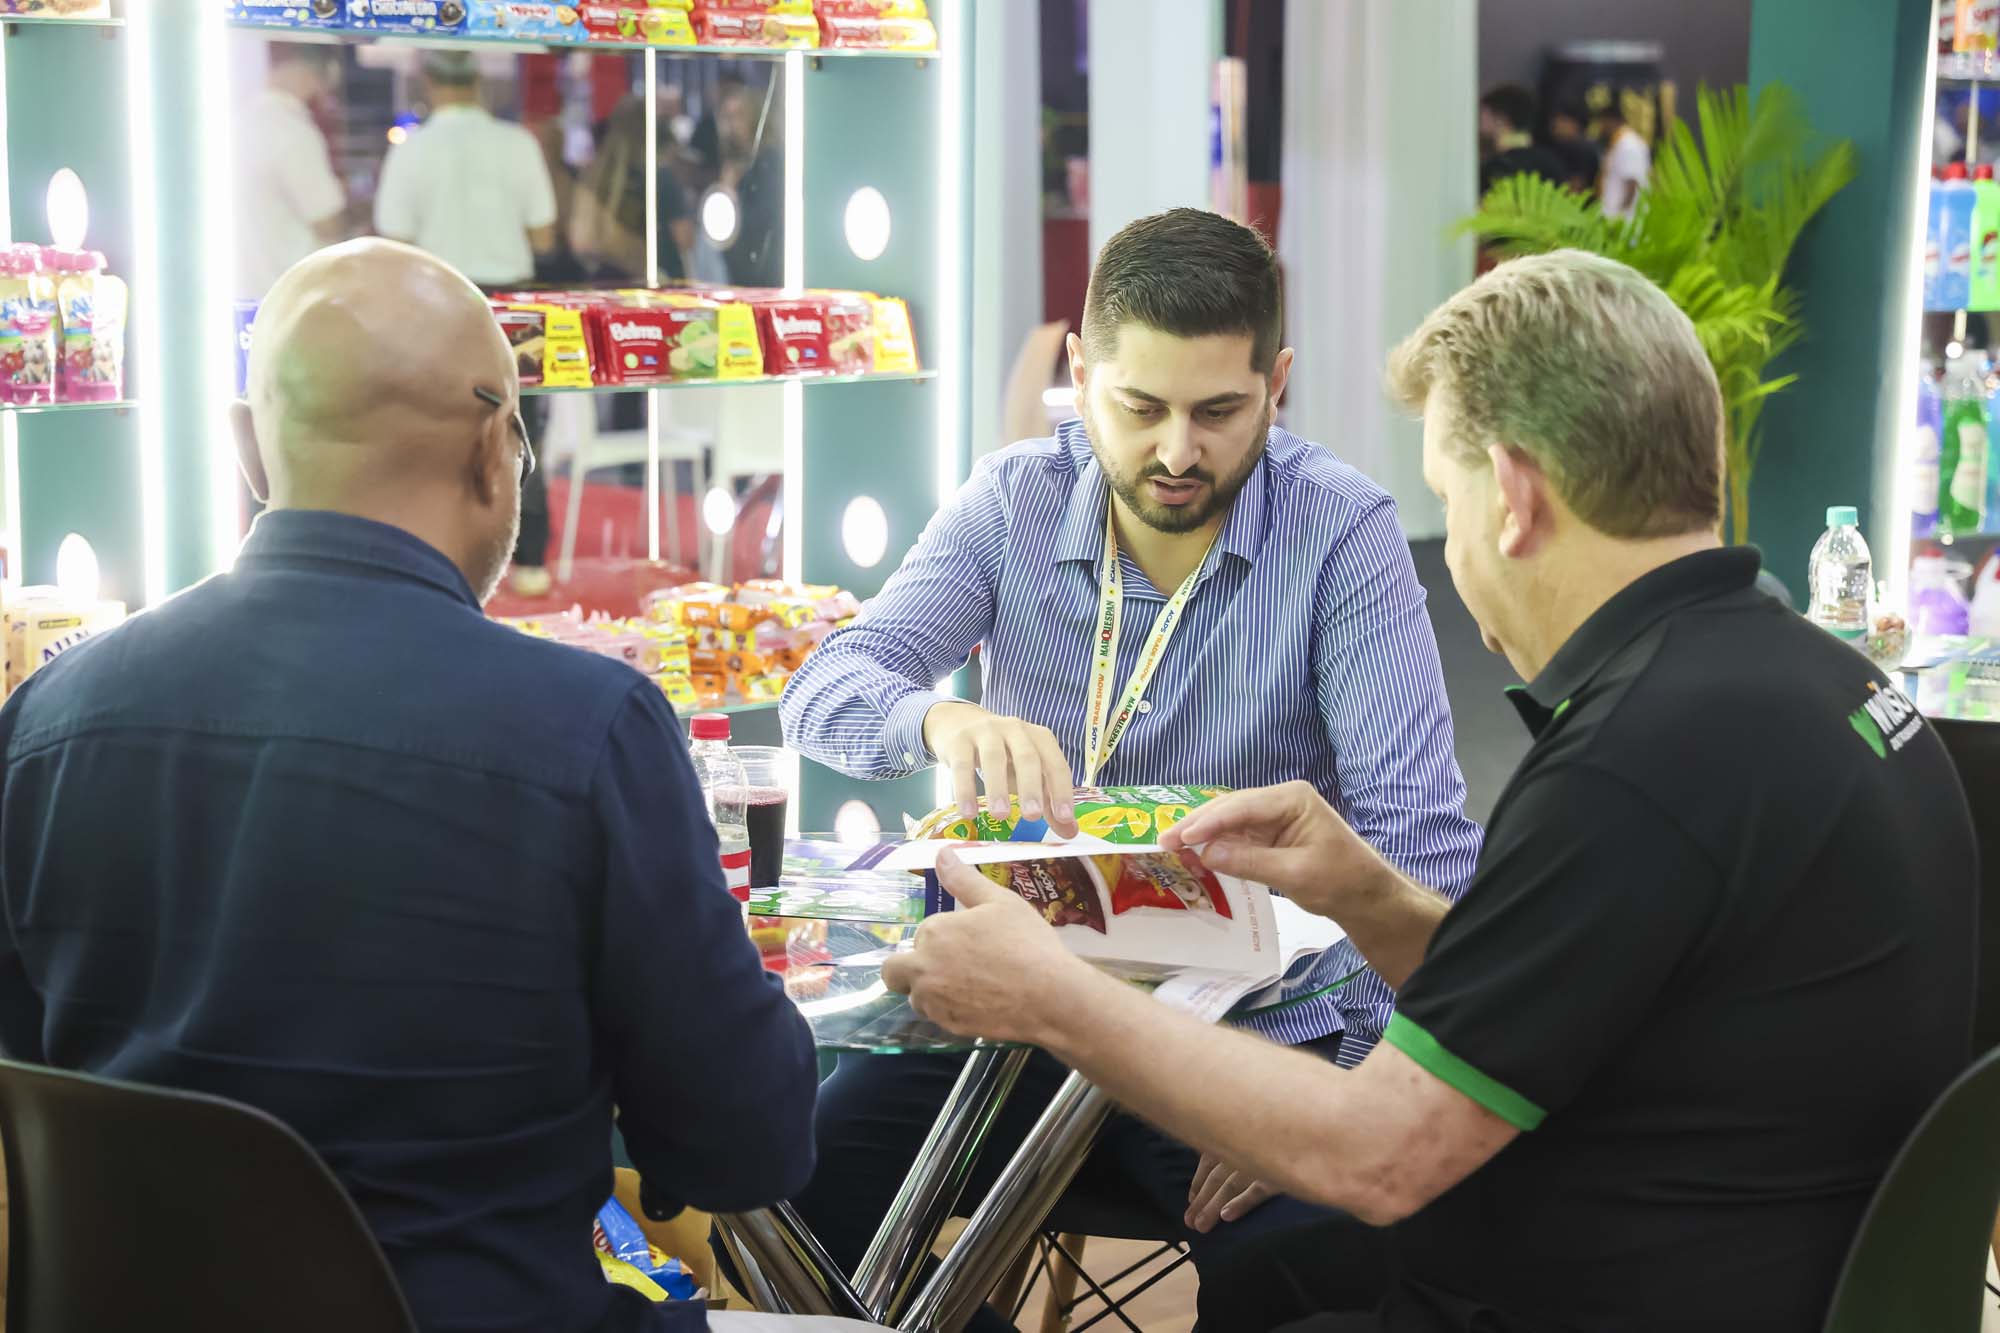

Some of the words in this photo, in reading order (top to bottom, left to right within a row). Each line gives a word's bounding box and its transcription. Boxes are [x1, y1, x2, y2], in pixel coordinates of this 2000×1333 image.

[1160, 609, 1175, 633] ACAPS
[1151, 633, 1164, 657] TRADE
[1096, 673, 1105, 700] SHOW
[1092, 700, 1102, 725] TRADE
[1031, 863, 1059, 900] BACON
